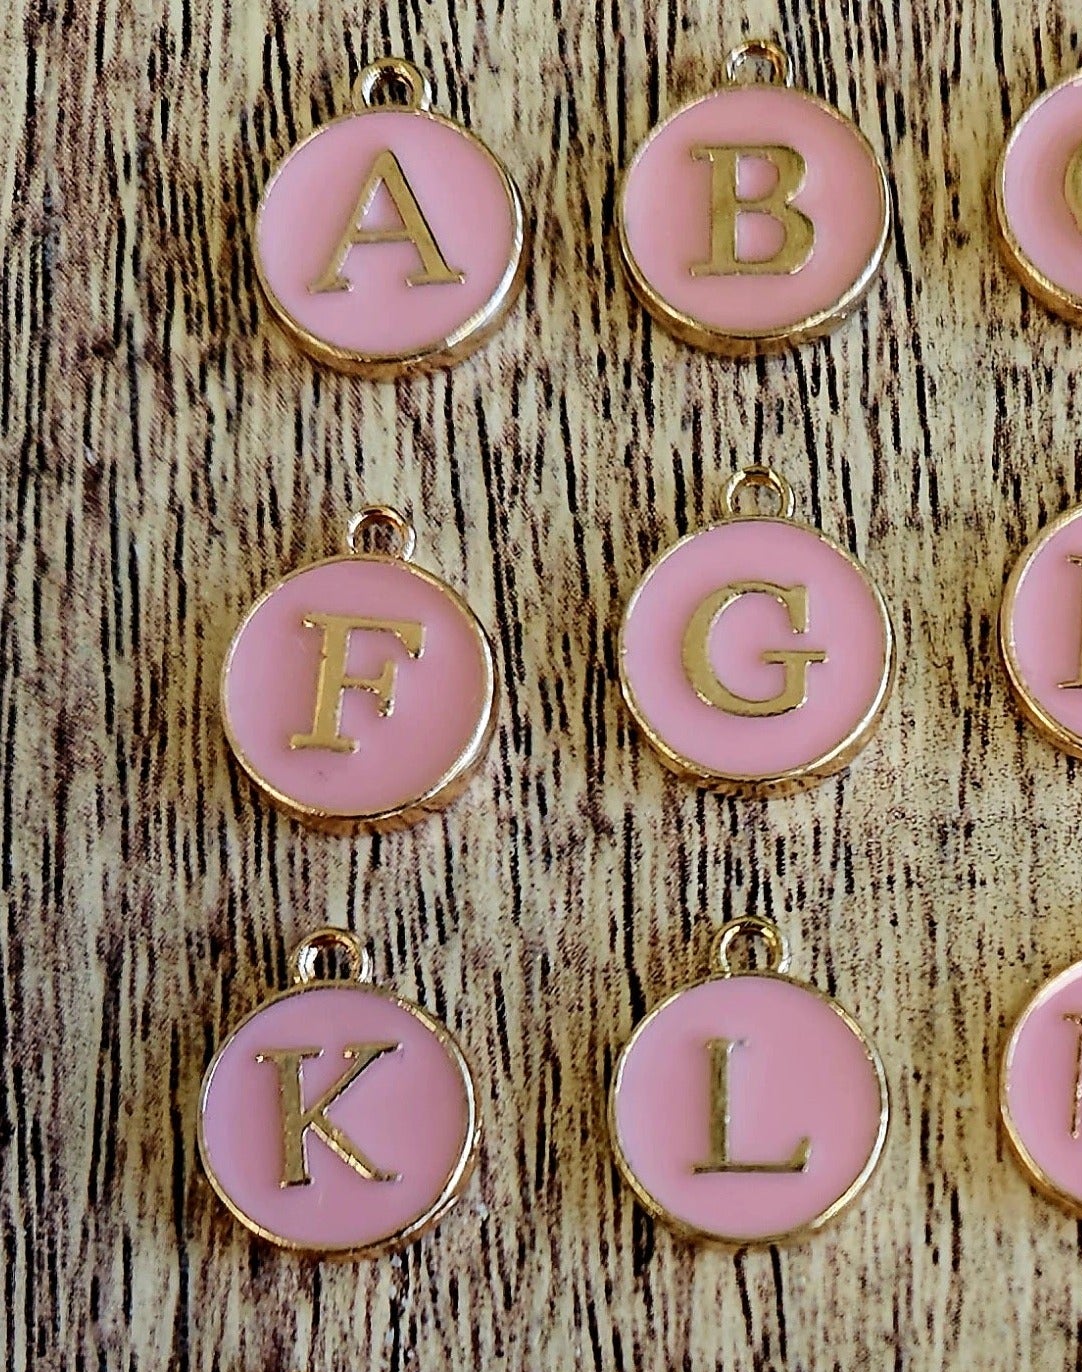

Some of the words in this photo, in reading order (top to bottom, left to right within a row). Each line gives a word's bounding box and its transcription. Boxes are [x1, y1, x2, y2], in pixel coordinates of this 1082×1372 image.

[307, 149, 465, 294] A
[690, 145, 816, 276] B
[290, 612, 426, 753] F
[682, 581, 828, 717] G
[254, 1042, 403, 1188] K
[693, 1039, 811, 1174] L
